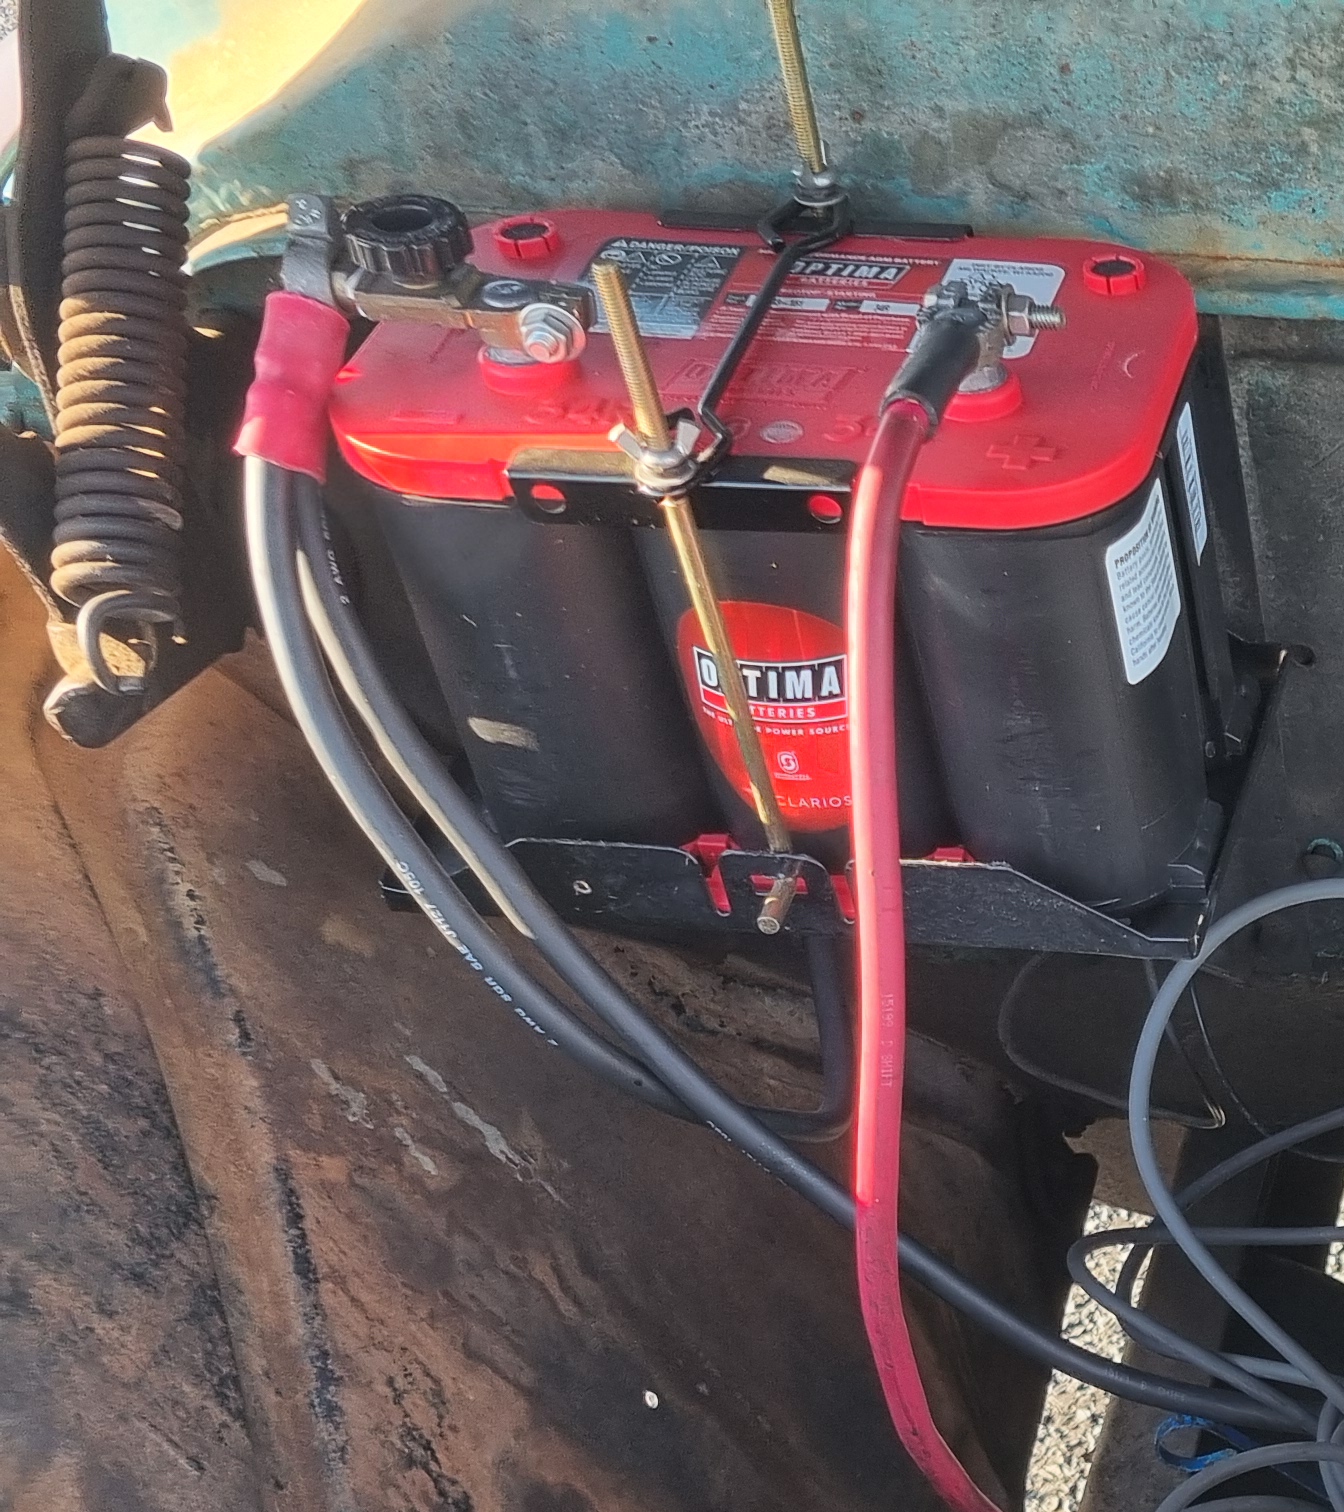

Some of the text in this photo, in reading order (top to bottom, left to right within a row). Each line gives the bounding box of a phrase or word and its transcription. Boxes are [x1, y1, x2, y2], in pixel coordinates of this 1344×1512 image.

[700, 657, 842, 700] OTIMA
[749, 705, 817, 719] TTERIES
[765, 724, 805, 736] POWER
[809, 723, 849, 736] SOURC
[775, 795, 853, 809] CLARIOS
[394, 859, 426, 896] 105C
[422, 899, 461, 941] J1127
